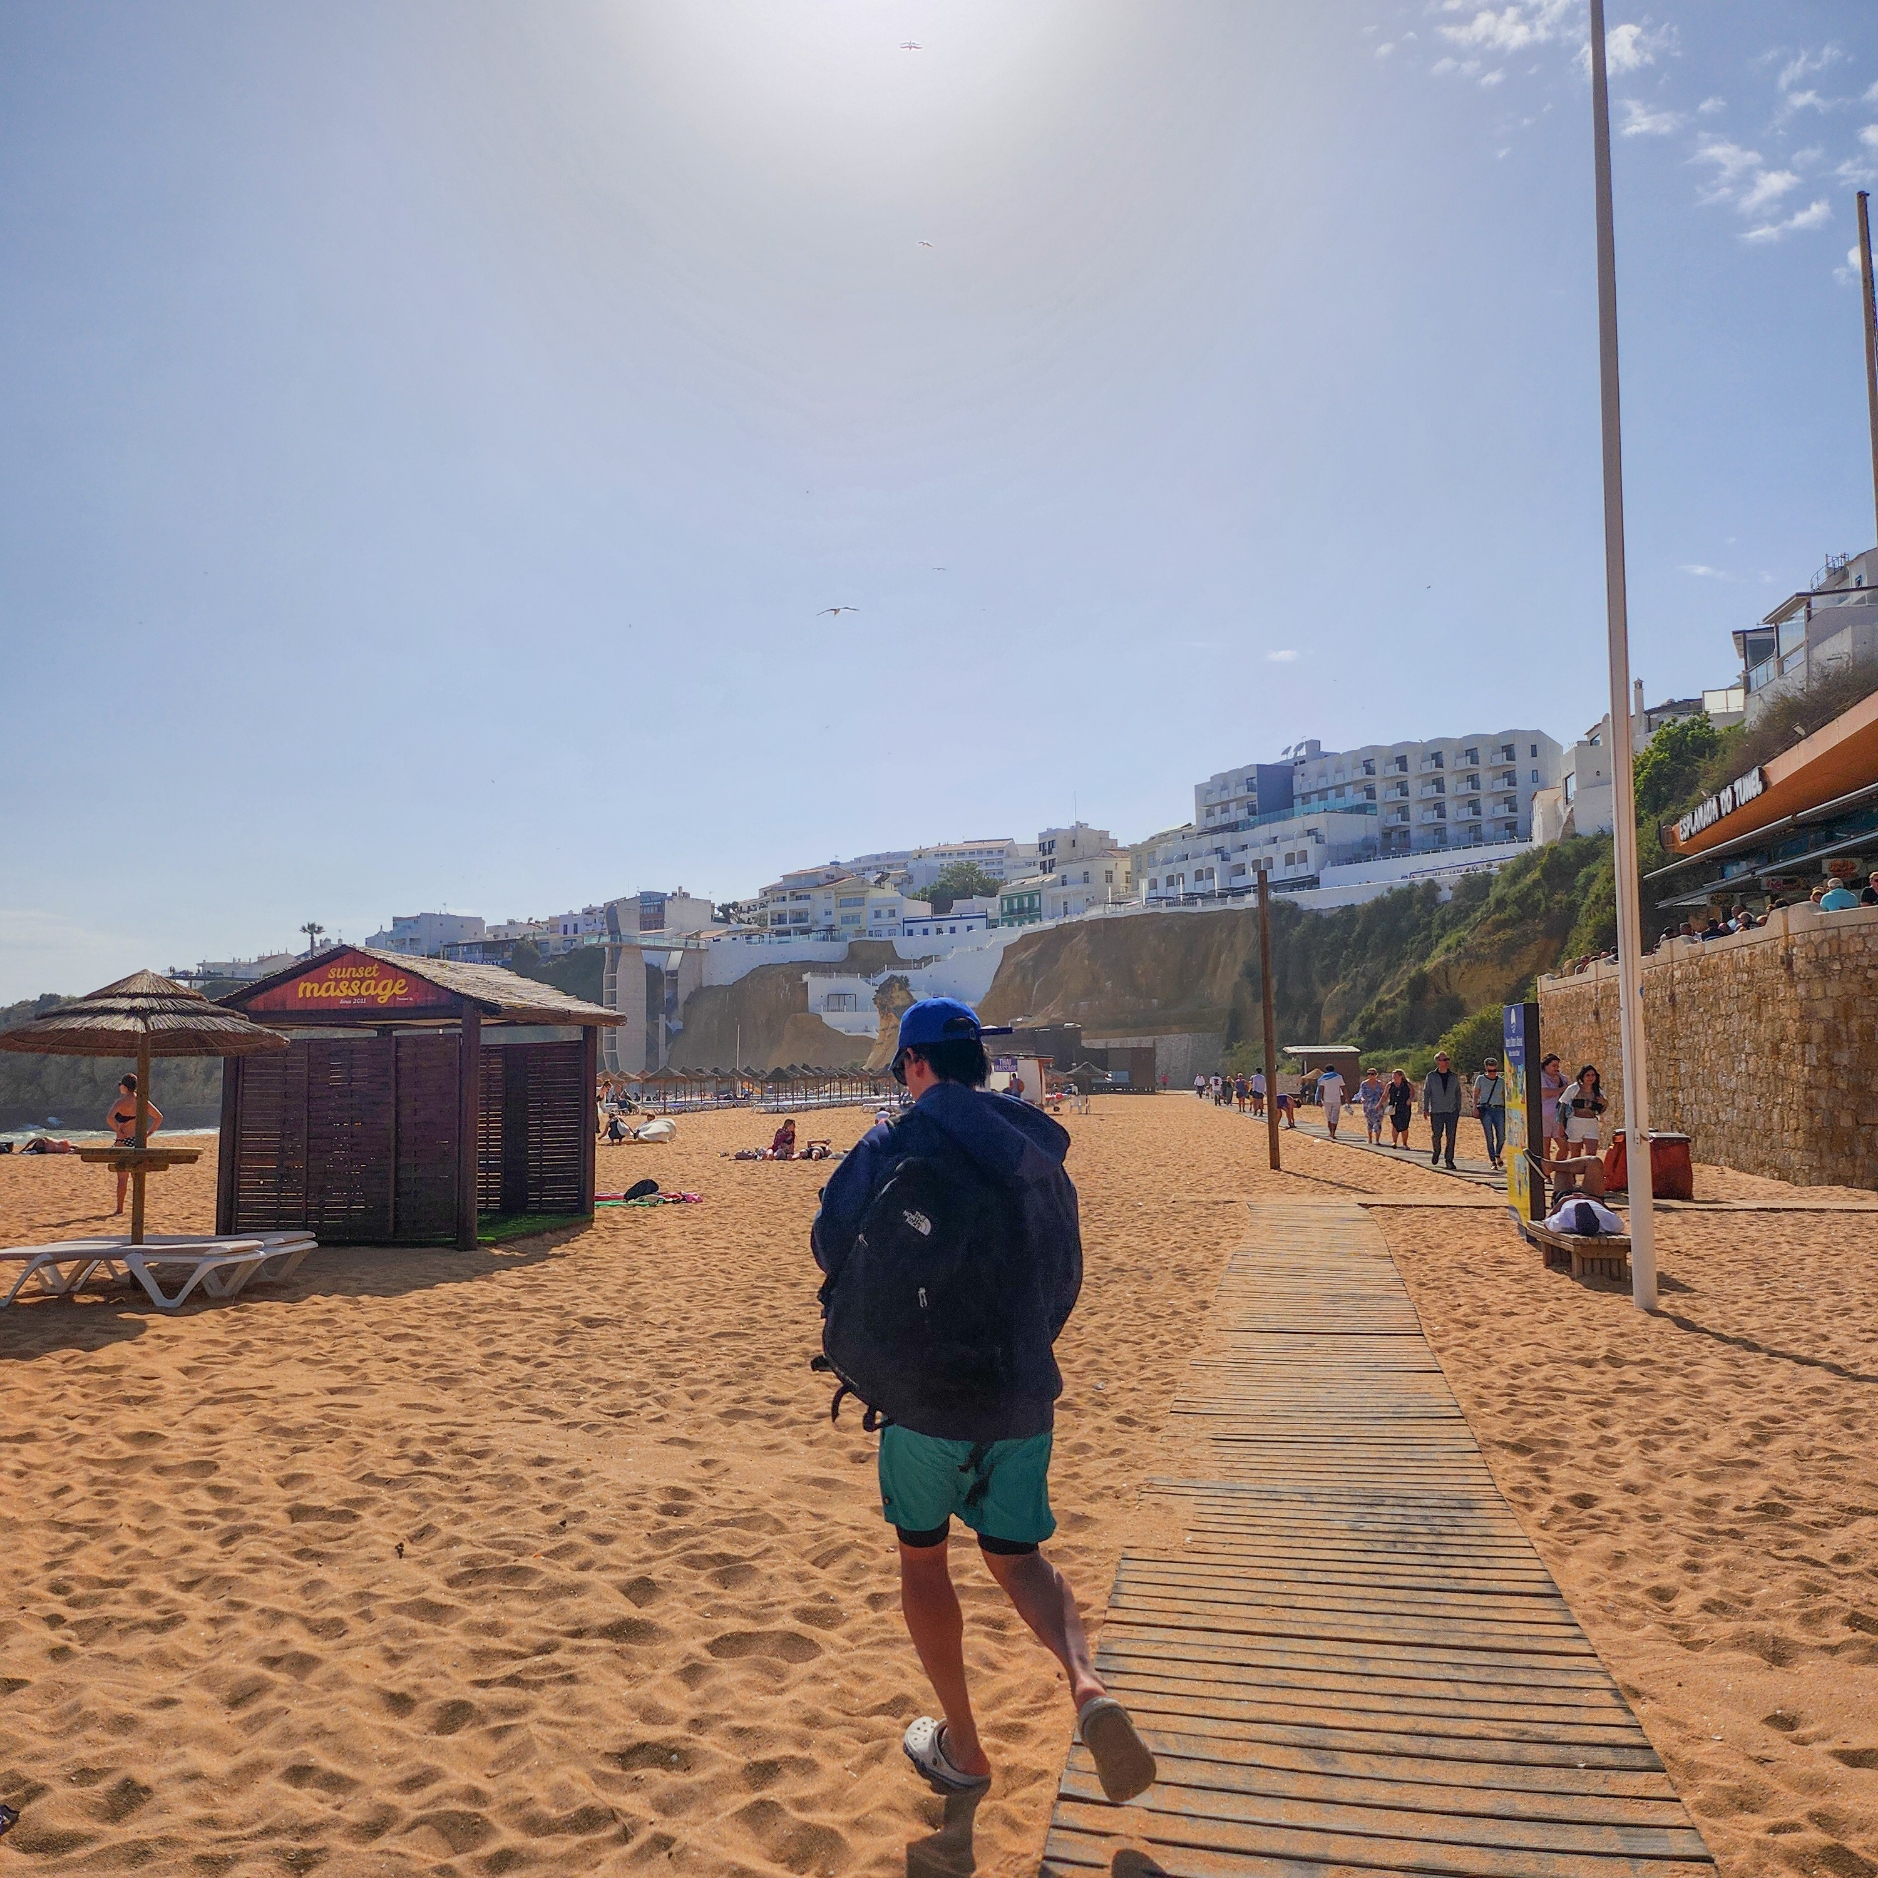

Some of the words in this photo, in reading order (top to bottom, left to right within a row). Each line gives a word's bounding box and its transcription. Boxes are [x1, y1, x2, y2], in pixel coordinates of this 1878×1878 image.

[1720, 785, 1733, 816] DO
[328, 963, 380, 978] sunset
[298, 979, 408, 1004] massage
